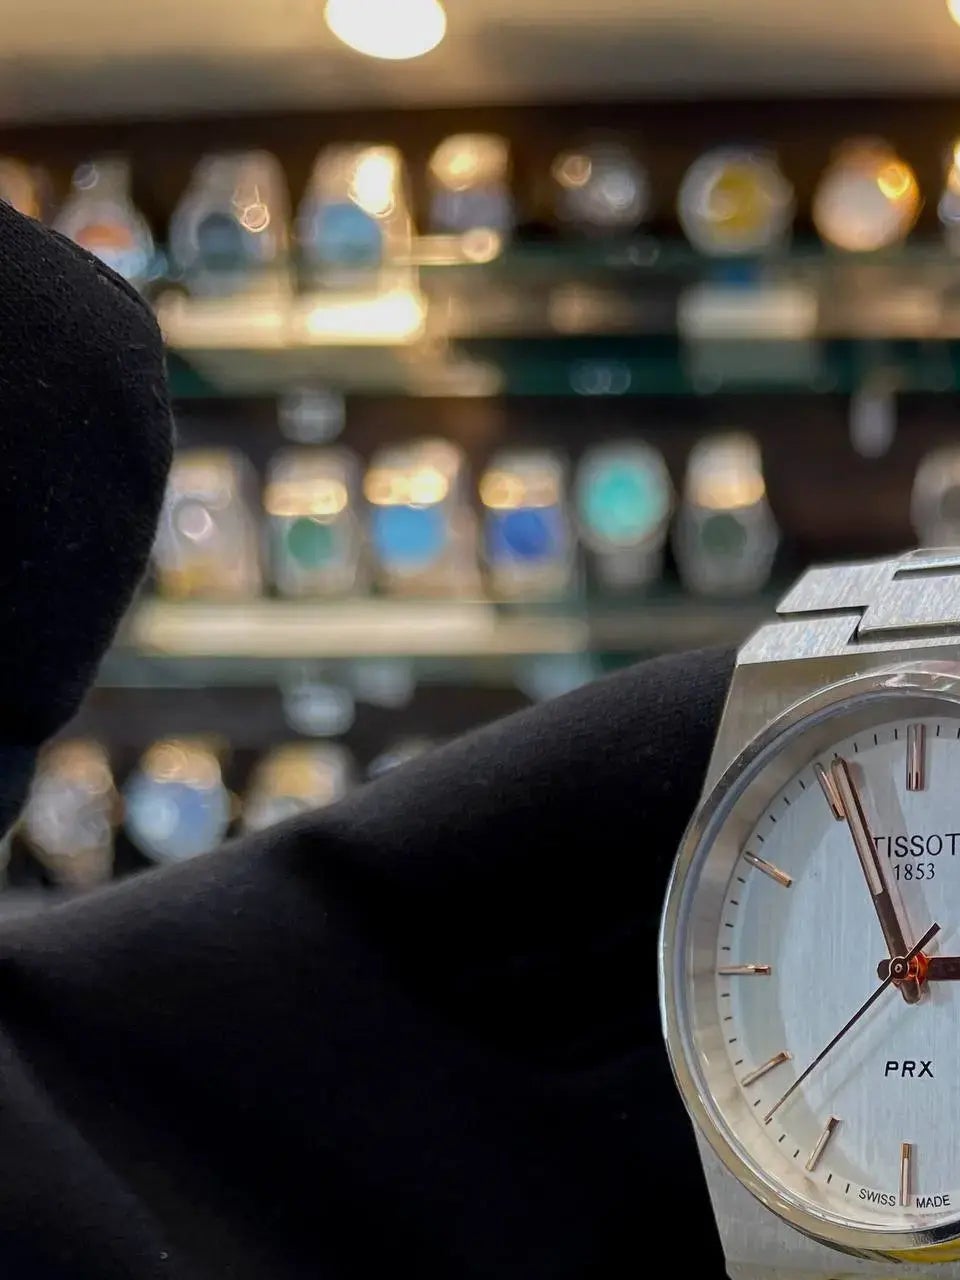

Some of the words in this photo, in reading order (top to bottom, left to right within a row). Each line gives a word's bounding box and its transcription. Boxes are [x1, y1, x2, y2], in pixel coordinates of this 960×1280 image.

[894, 863, 935, 880] 1853
[884, 1061, 934, 1078] PRX
[858, 1188, 896, 1207] SWISS
[916, 1195, 950, 1208] MADE
